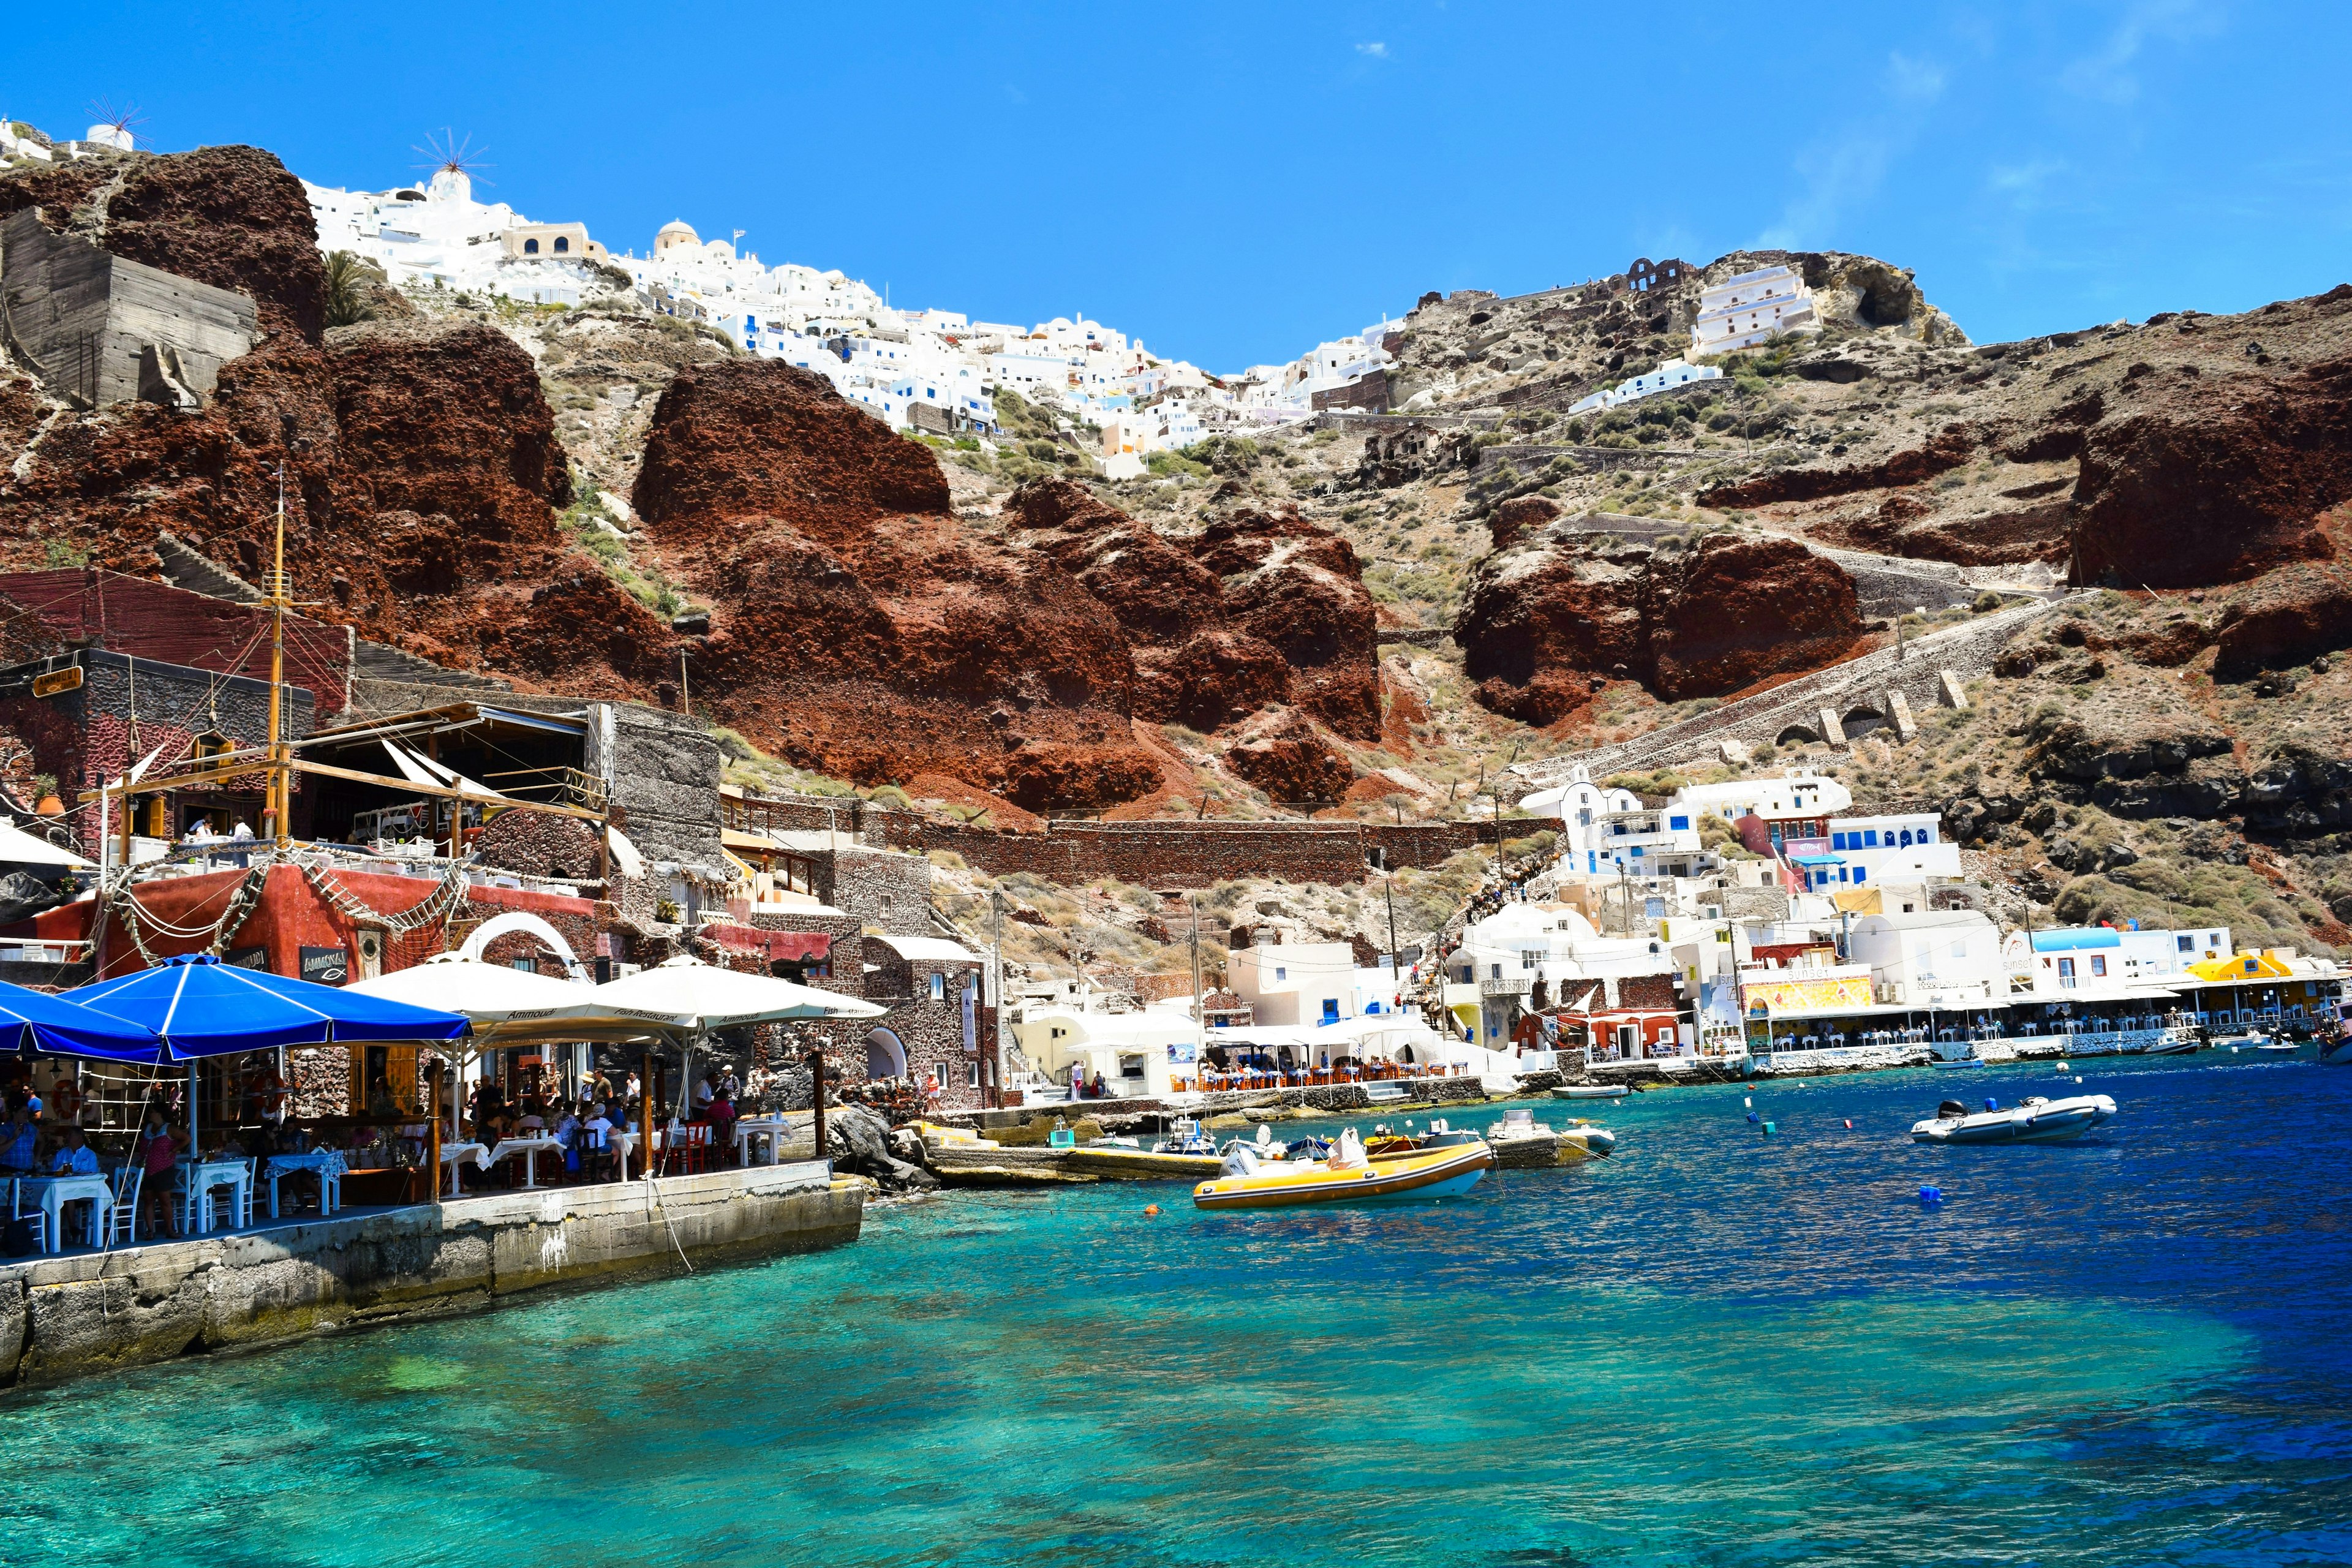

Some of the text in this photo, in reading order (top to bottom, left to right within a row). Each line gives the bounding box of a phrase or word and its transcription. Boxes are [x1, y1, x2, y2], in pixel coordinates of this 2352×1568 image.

[39, 669, 77, 687] AMMOUDI
[1721, 974, 1741, 985] sunst
[507, 1008, 557, 1020] Ammoudi
[614, 1008, 677, 1022] Fish Restaurant
[718, 1012, 761, 1023] Ammoudi
